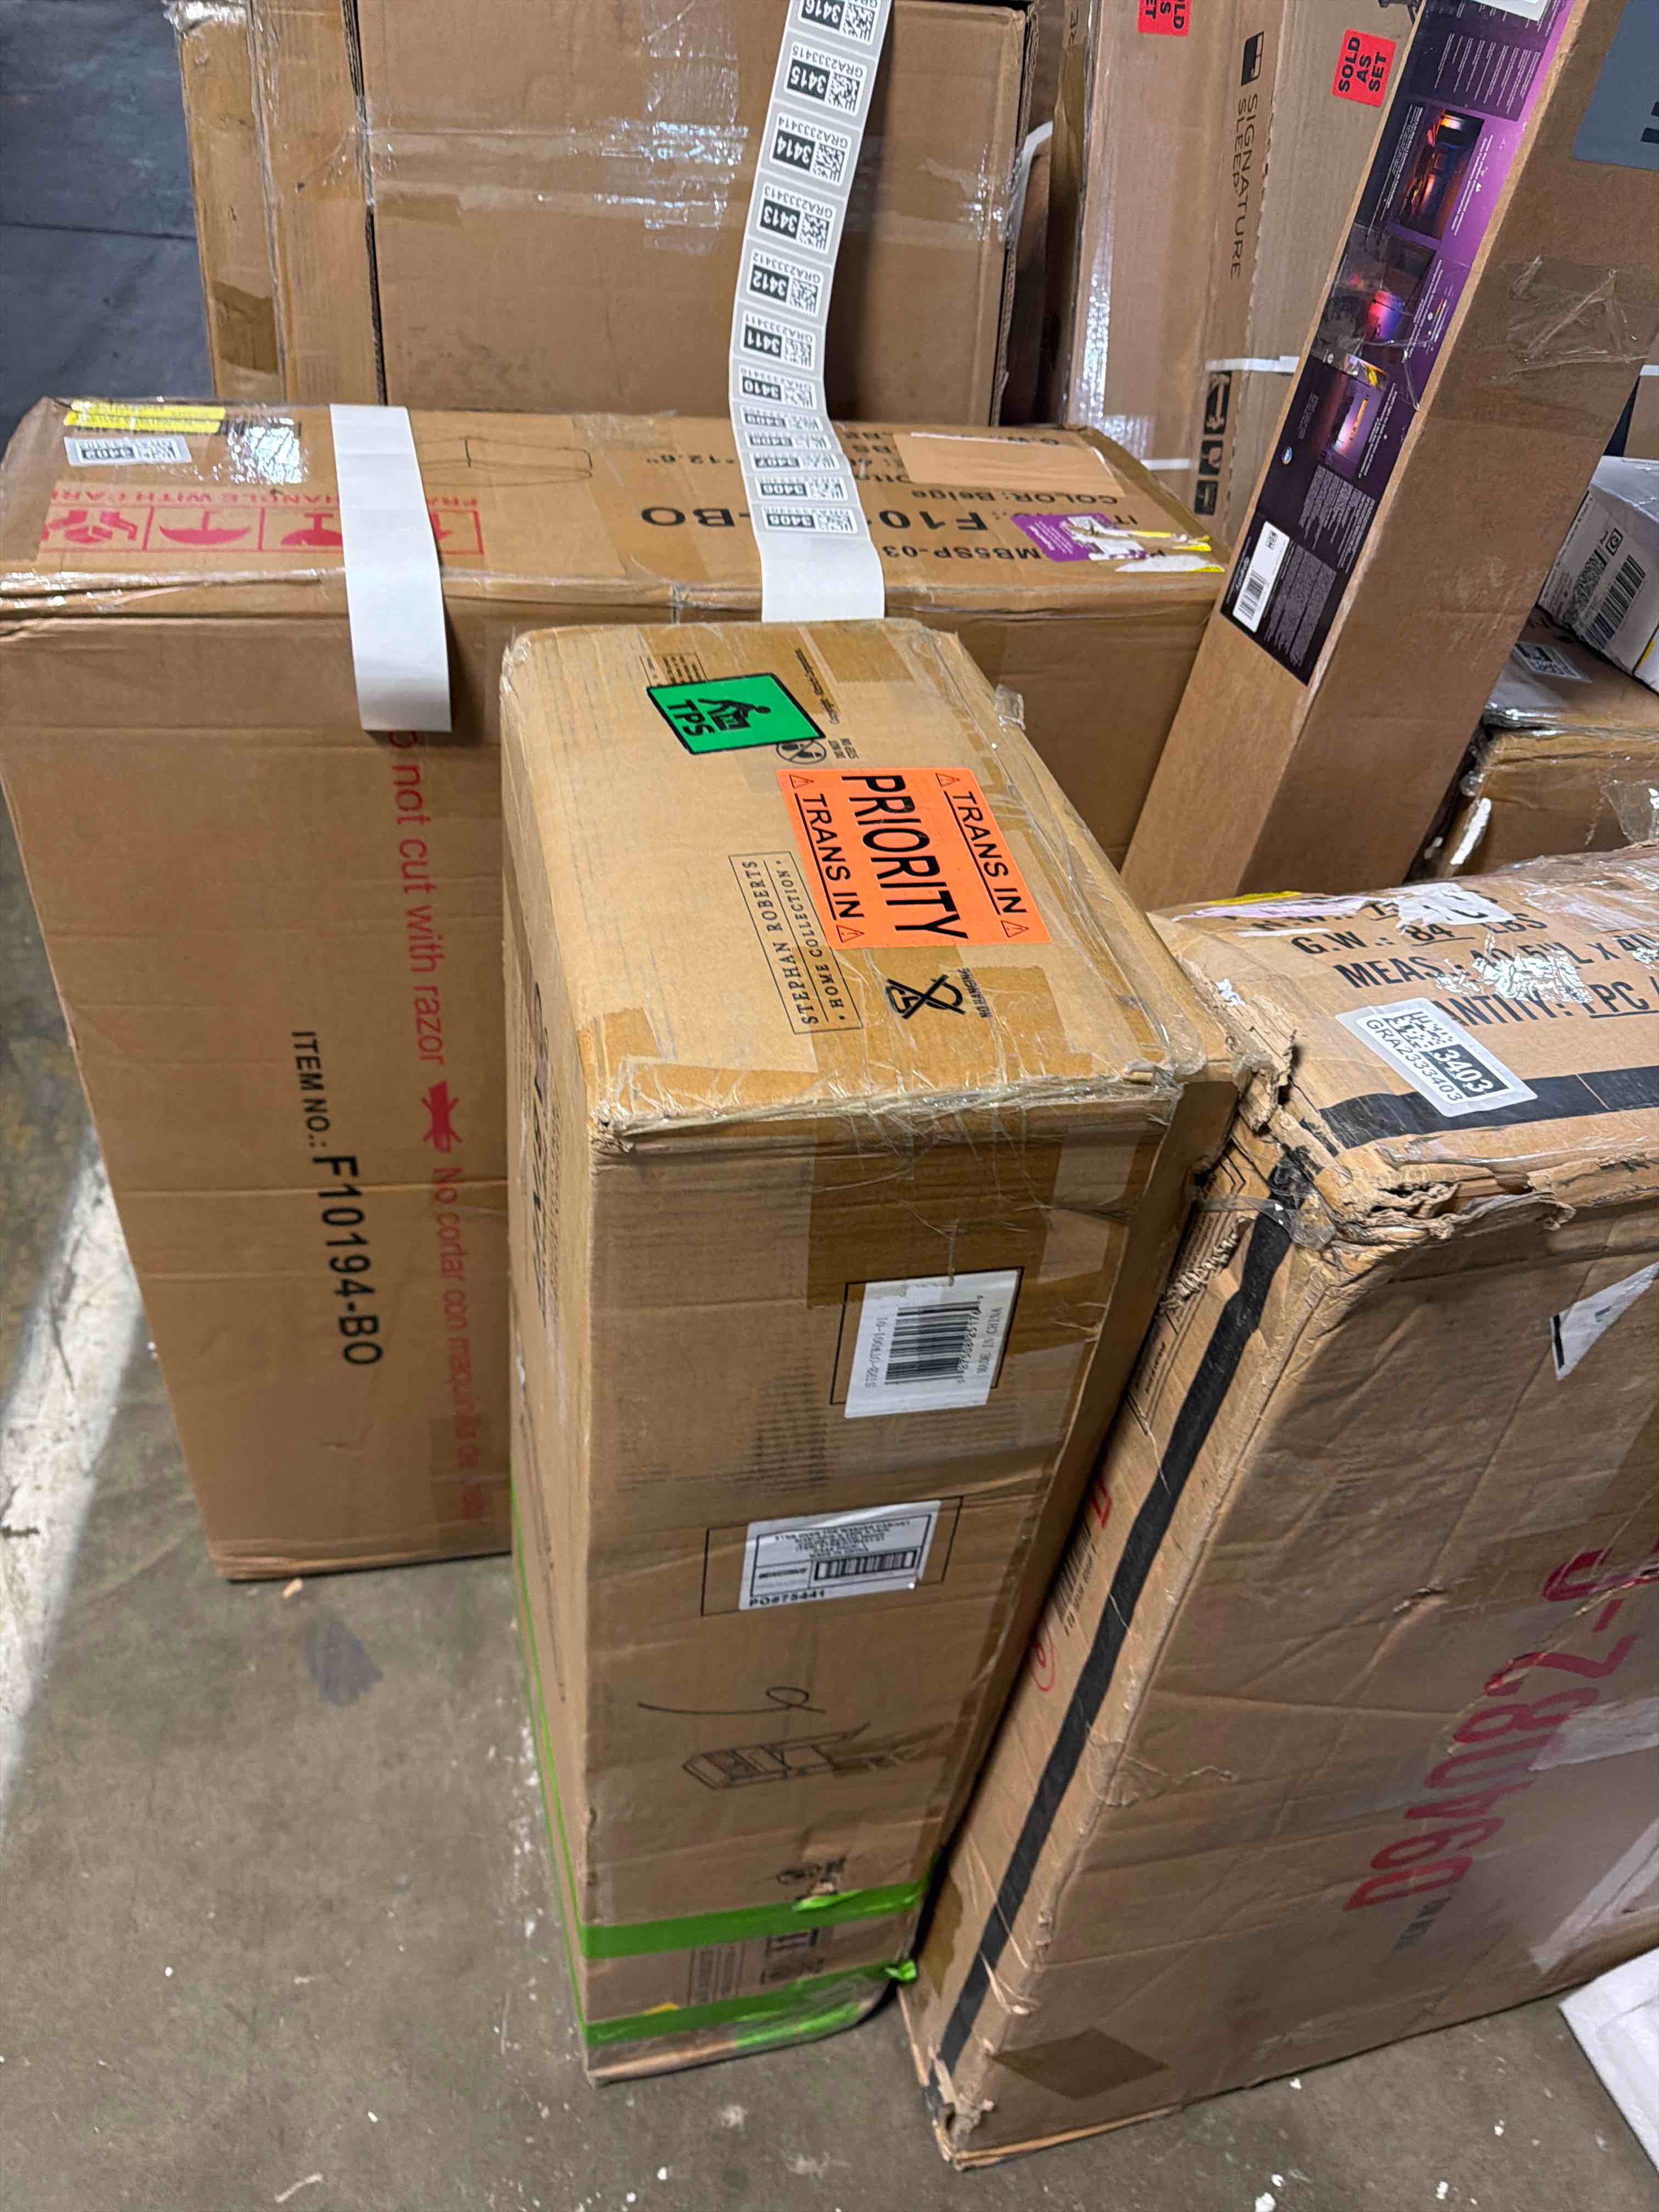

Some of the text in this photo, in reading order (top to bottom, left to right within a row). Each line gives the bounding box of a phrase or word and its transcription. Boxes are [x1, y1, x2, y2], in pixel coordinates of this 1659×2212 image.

[1173, 0, 1185, 29] LD
[791, 67, 827, 88] 3415
[793, 45, 864, 78] GRA2333415
[1338, 36, 1361, 93] SOLD
[1356, 54, 1372, 83] AS
[1368, 52, 1388, 92] SET
[776, 136, 811, 157] 3414
[778, 116, 849, 148] GRA2333414
[1232, 99, 1247, 189] SLEEP
[764, 185, 833, 218] GRA2333413
[1230, 93, 1258, 279] SIGNATURE
[763, 205, 797, 226] 3413
[752, 269, 787, 291] 3412
[753, 252, 821, 284] GRA2333412
[747, 330, 780, 354] 3411
[743, 380, 780, 399] 3410
[911, 489, 1118, 504] COLOR: Beige
[882, 545, 1042, 560] MB5SP-03
[665, 698, 715, 738] TPS
[391, 764, 431, 826] not
[398, 838, 437, 895] cut
[802, 793, 864, 919] TRANS IN
[842, 774, 969, 940] PRIORITY
[952, 791, 1029, 915] TRANS IN
[404, 905, 445, 973] with
[742, 860, 819, 1025] STEPHAN ROBERTS
[777, 867, 844, 1015] HOME COLLECTION
[413, 984, 445, 1065] razor
[1365, 1019, 1464, 1102] GRA2333403
[1433, 1049, 1494, 1093] 3403
[291, 1030, 325, 1091] ITEM
[311, 1154, 383, 1367] F10194-BO
[435, 1206, 466, 1282] cortar
